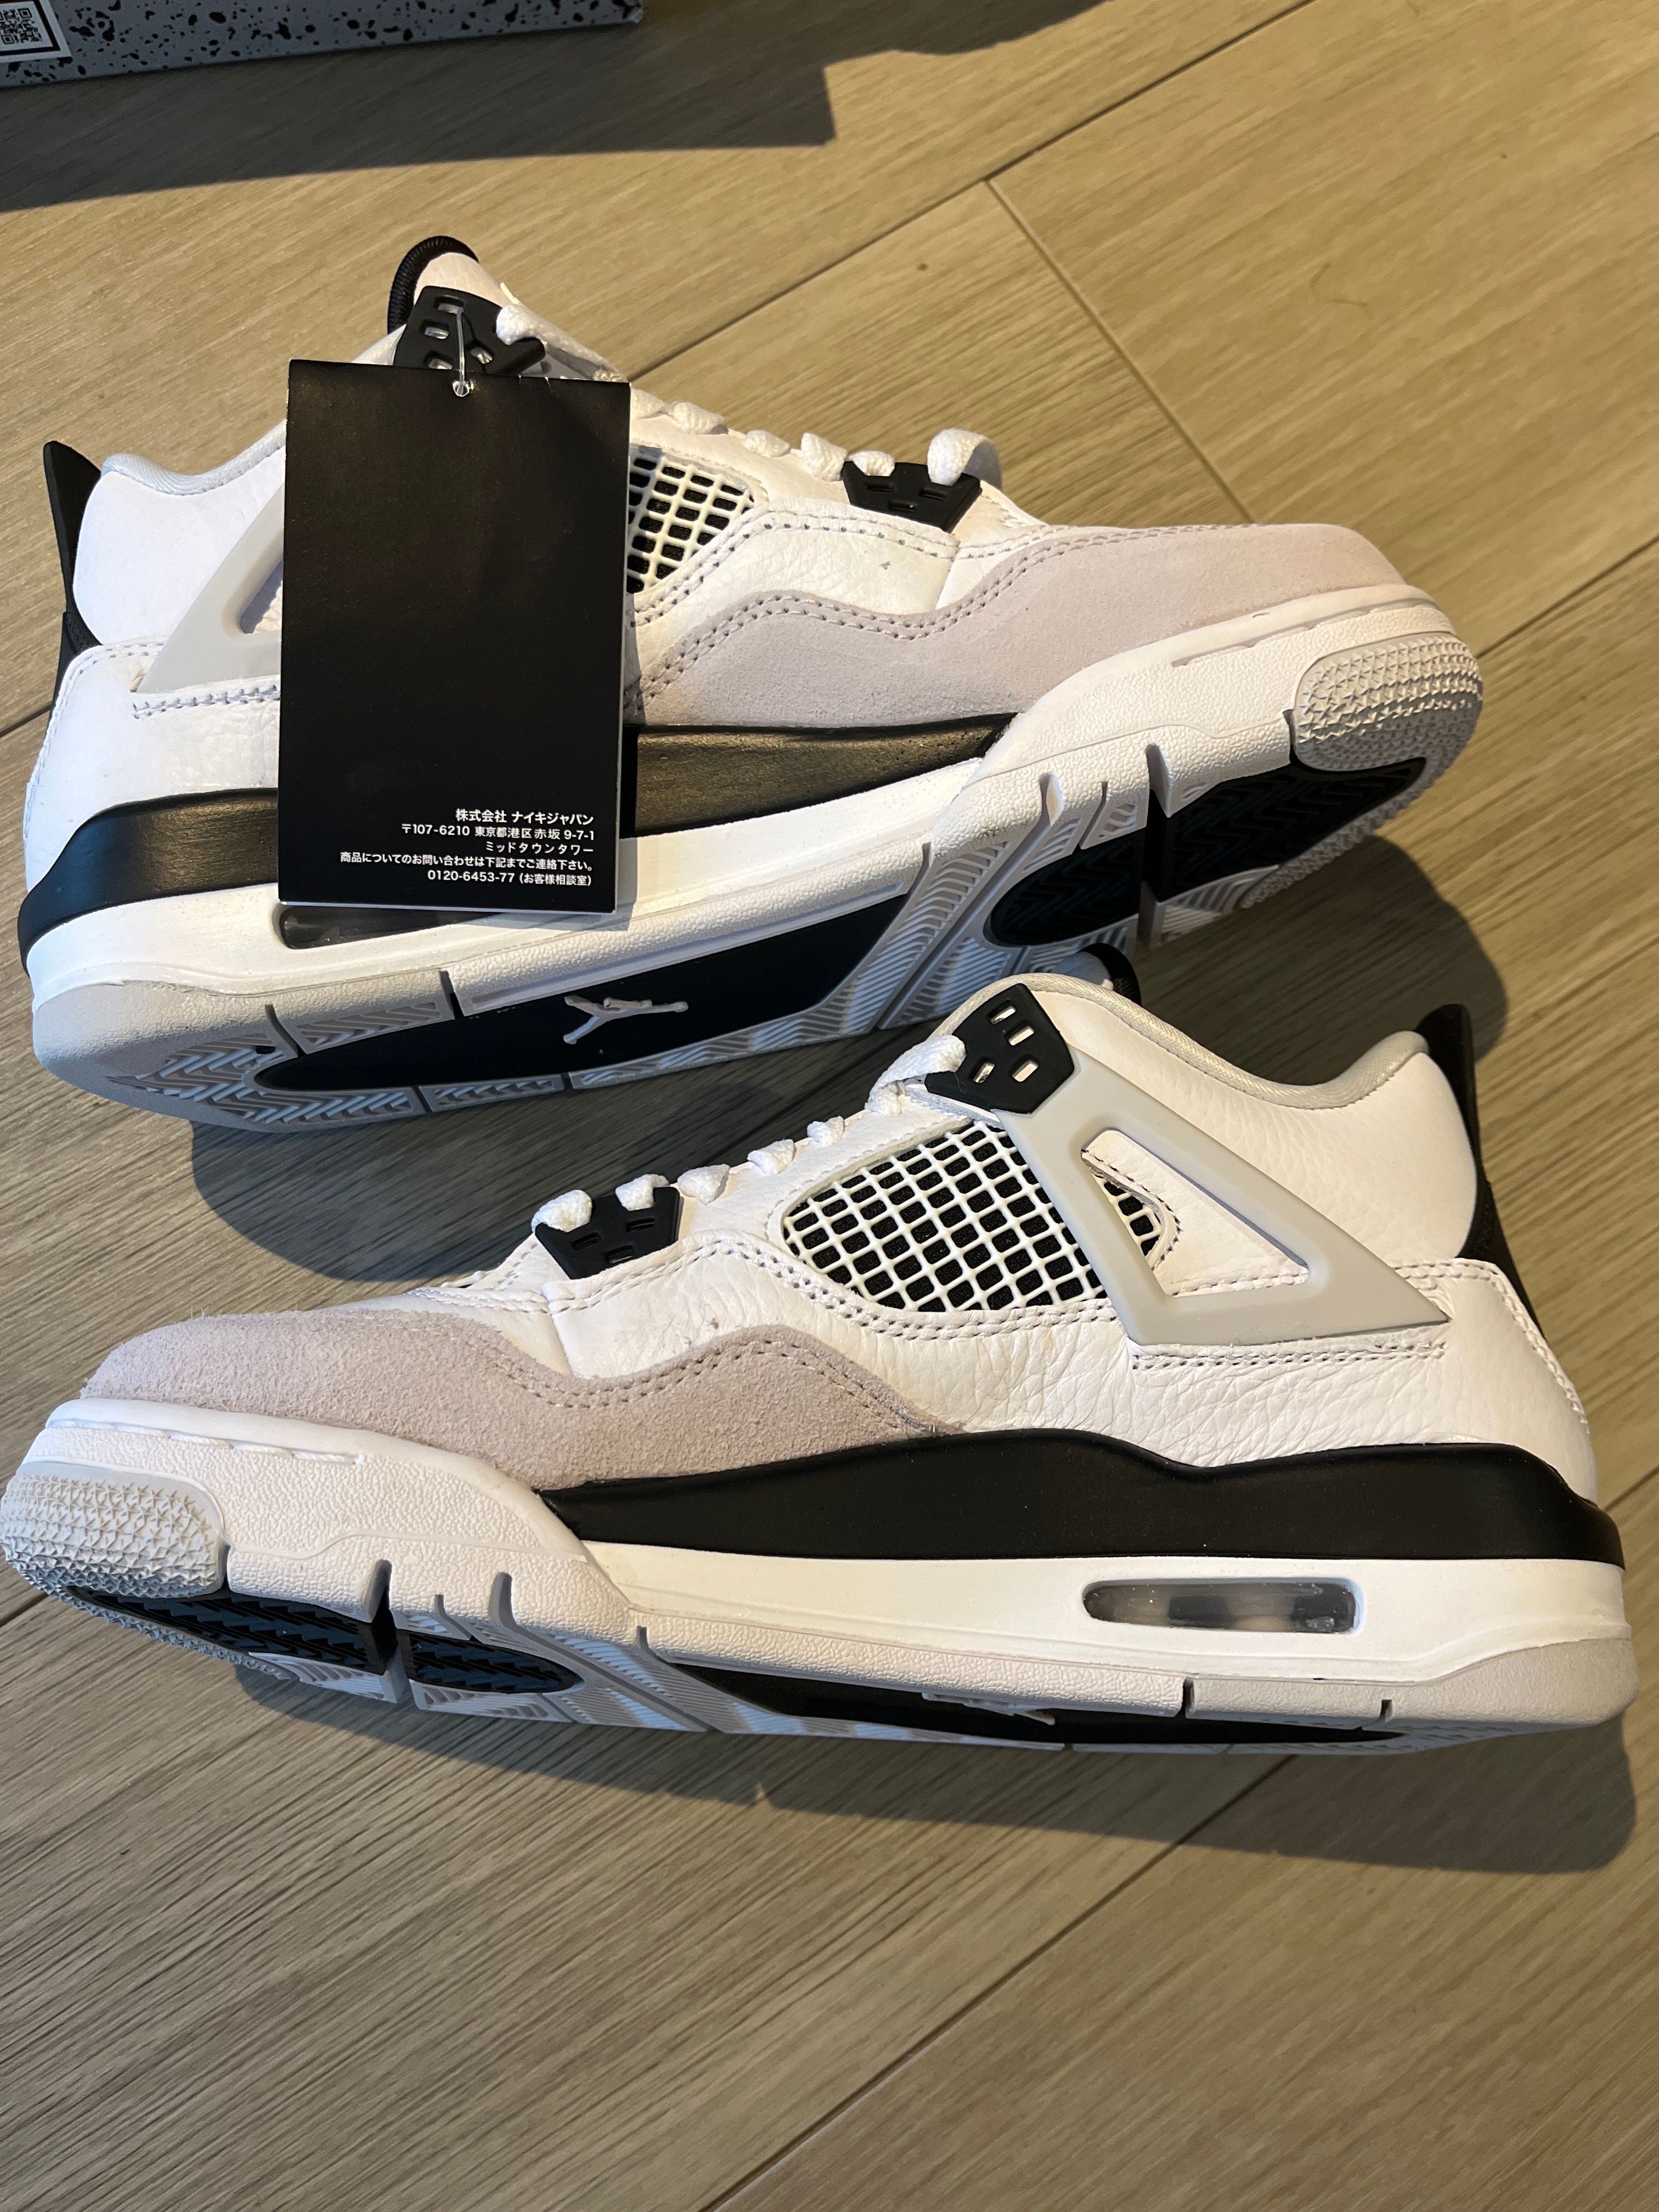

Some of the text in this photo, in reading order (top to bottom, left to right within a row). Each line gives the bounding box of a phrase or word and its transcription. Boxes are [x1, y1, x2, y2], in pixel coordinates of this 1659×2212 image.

[455, 808, 594, 825] 株式会社 ナイキジャパン
[475, 826, 561, 840] 東京都港区赤坂
[563, 829, 594, 840] 9-7-1
[486, 841, 594, 856] ミッドタウンタワー
[340, 851, 592, 871] 商品についてのお問い合わせは下記までご連絡下さい。
[427, 870, 515, 883] 0120-6453-77
